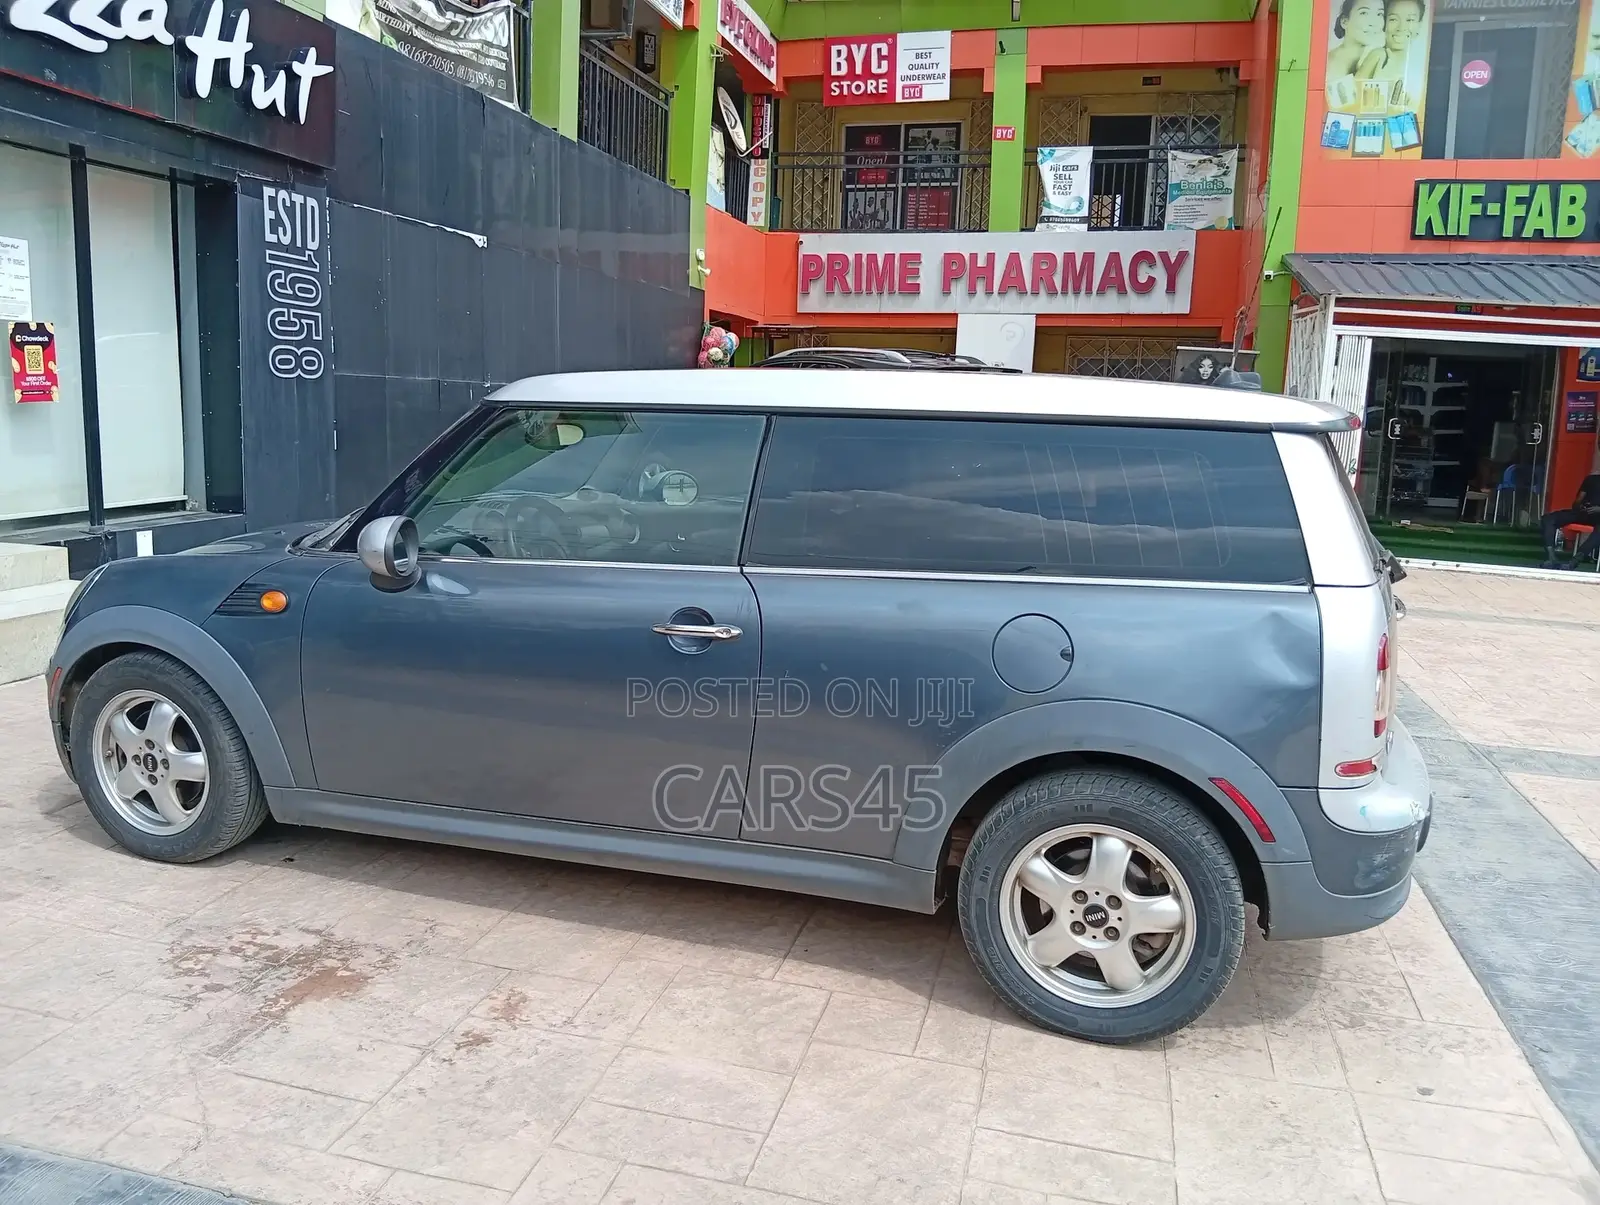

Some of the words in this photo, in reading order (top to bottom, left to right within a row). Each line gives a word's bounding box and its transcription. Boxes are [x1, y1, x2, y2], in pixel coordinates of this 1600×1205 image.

[830, 42, 889, 76] BYC
[915, 51, 933, 60] BEST
[185, 0, 334, 125] Hut
[907, 62, 940, 71] QUALITY
[900, 73, 947, 82] UNDERWEAR
[1463, 70, 1489, 79] OPEN
[830, 79, 889, 96] STORE
[903, 87, 921, 98] BYC
[996, 128, 1013, 139] BYC
[1053, 173, 1073, 181] SELL
[1415, 183, 1587, 238] KIF-FAB
[262, 185, 320, 251] ESTD
[800, 252, 923, 294] PRIME
[941, 250, 1190, 294] PHARMACY
[265, 249, 324, 380] 1958
[1085, 911, 1106, 922] MINI
